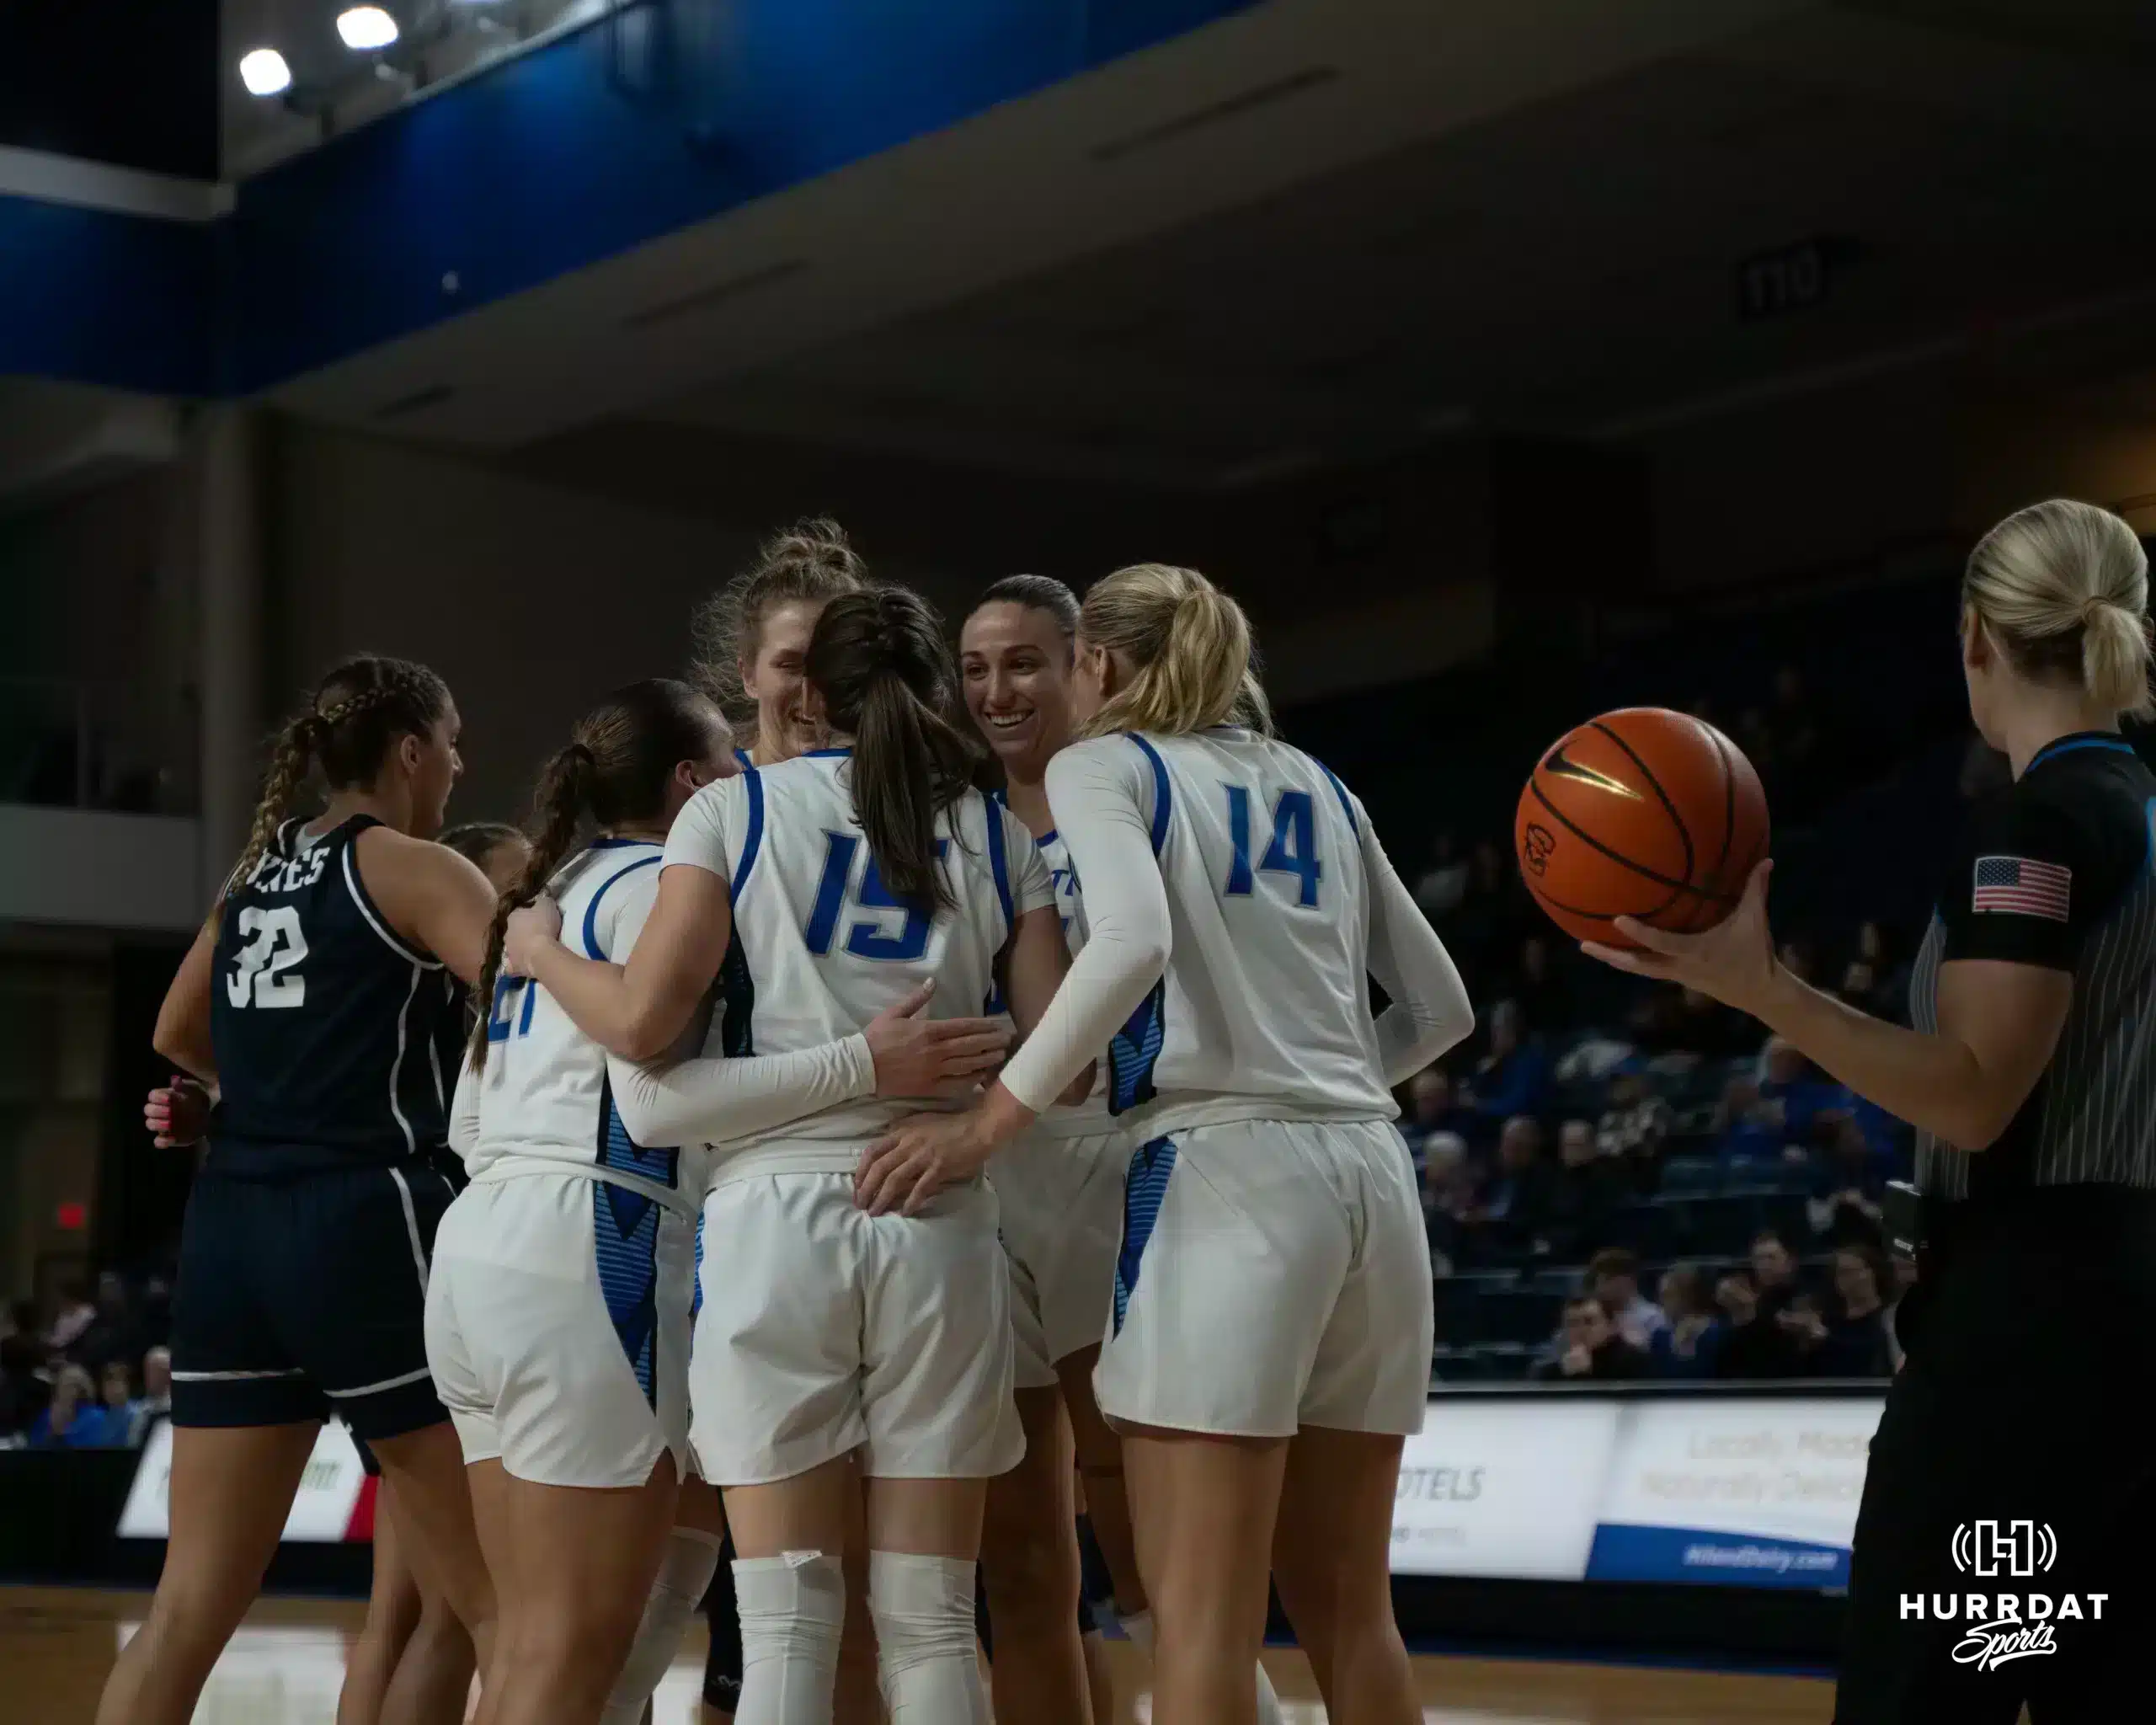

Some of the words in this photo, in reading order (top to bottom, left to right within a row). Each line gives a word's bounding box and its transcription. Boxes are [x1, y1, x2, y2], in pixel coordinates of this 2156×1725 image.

[806, 829, 953, 962] 15
[1219, 781, 1322, 910] 14
[227, 905, 310, 1009] 32
